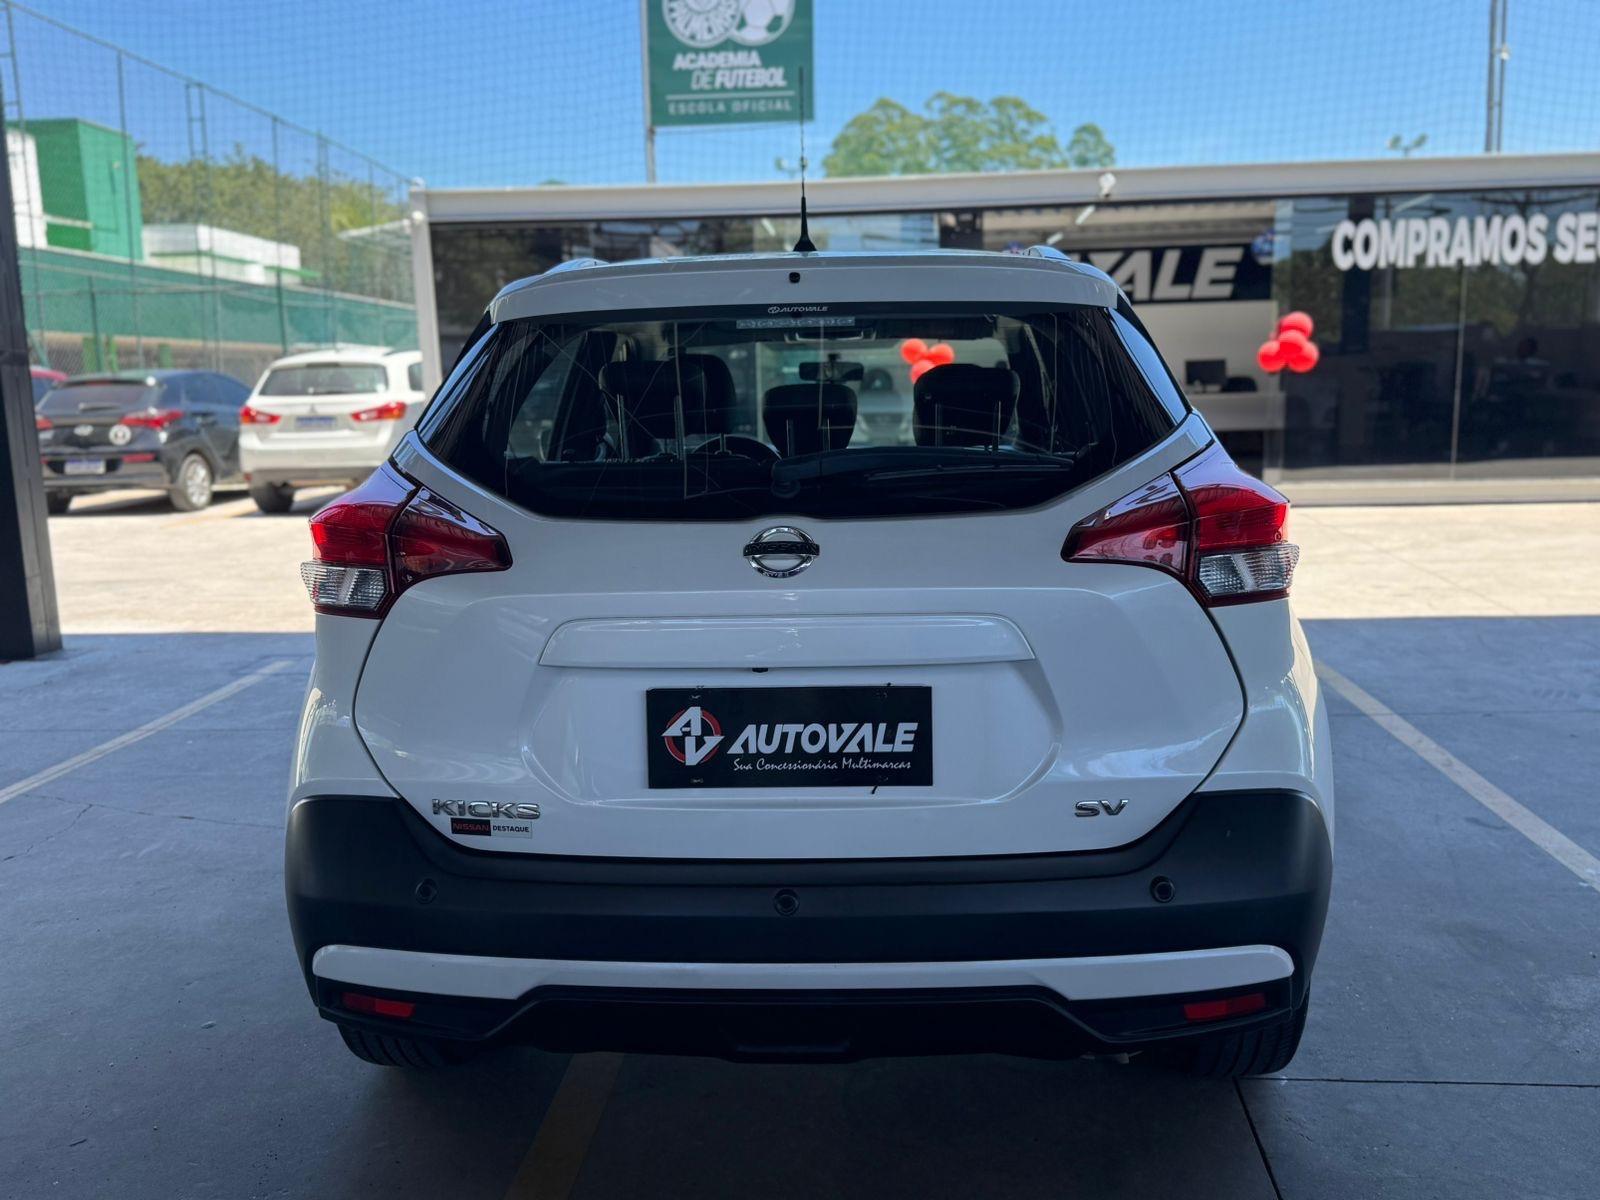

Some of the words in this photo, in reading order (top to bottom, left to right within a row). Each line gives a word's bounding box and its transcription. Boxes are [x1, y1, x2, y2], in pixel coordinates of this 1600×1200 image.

[674, 51, 762, 70] ACADEMIA
[690, 70, 715, 90] DE
[715, 67, 788, 87] FUTEBOL
[668, 100, 726, 115] ESCOLA
[732, 99, 792, 113] OFICIAL
[1332, 212, 1549, 271] COMPRAMOS
[1552, 211, 1600, 264] SE
[727, 722, 919, 754] AUTOVALE
[733, 757, 753, 771] Sua
[756, 758, 838, 771] Concessionária
[842, 757, 911, 770] Multimarcas
[432, 799, 541, 820] KICKS
[1074, 799, 1129, 817] SV
[452, 821, 490, 833] NISSAN
[492, 825, 530, 833] DESTAQUE
